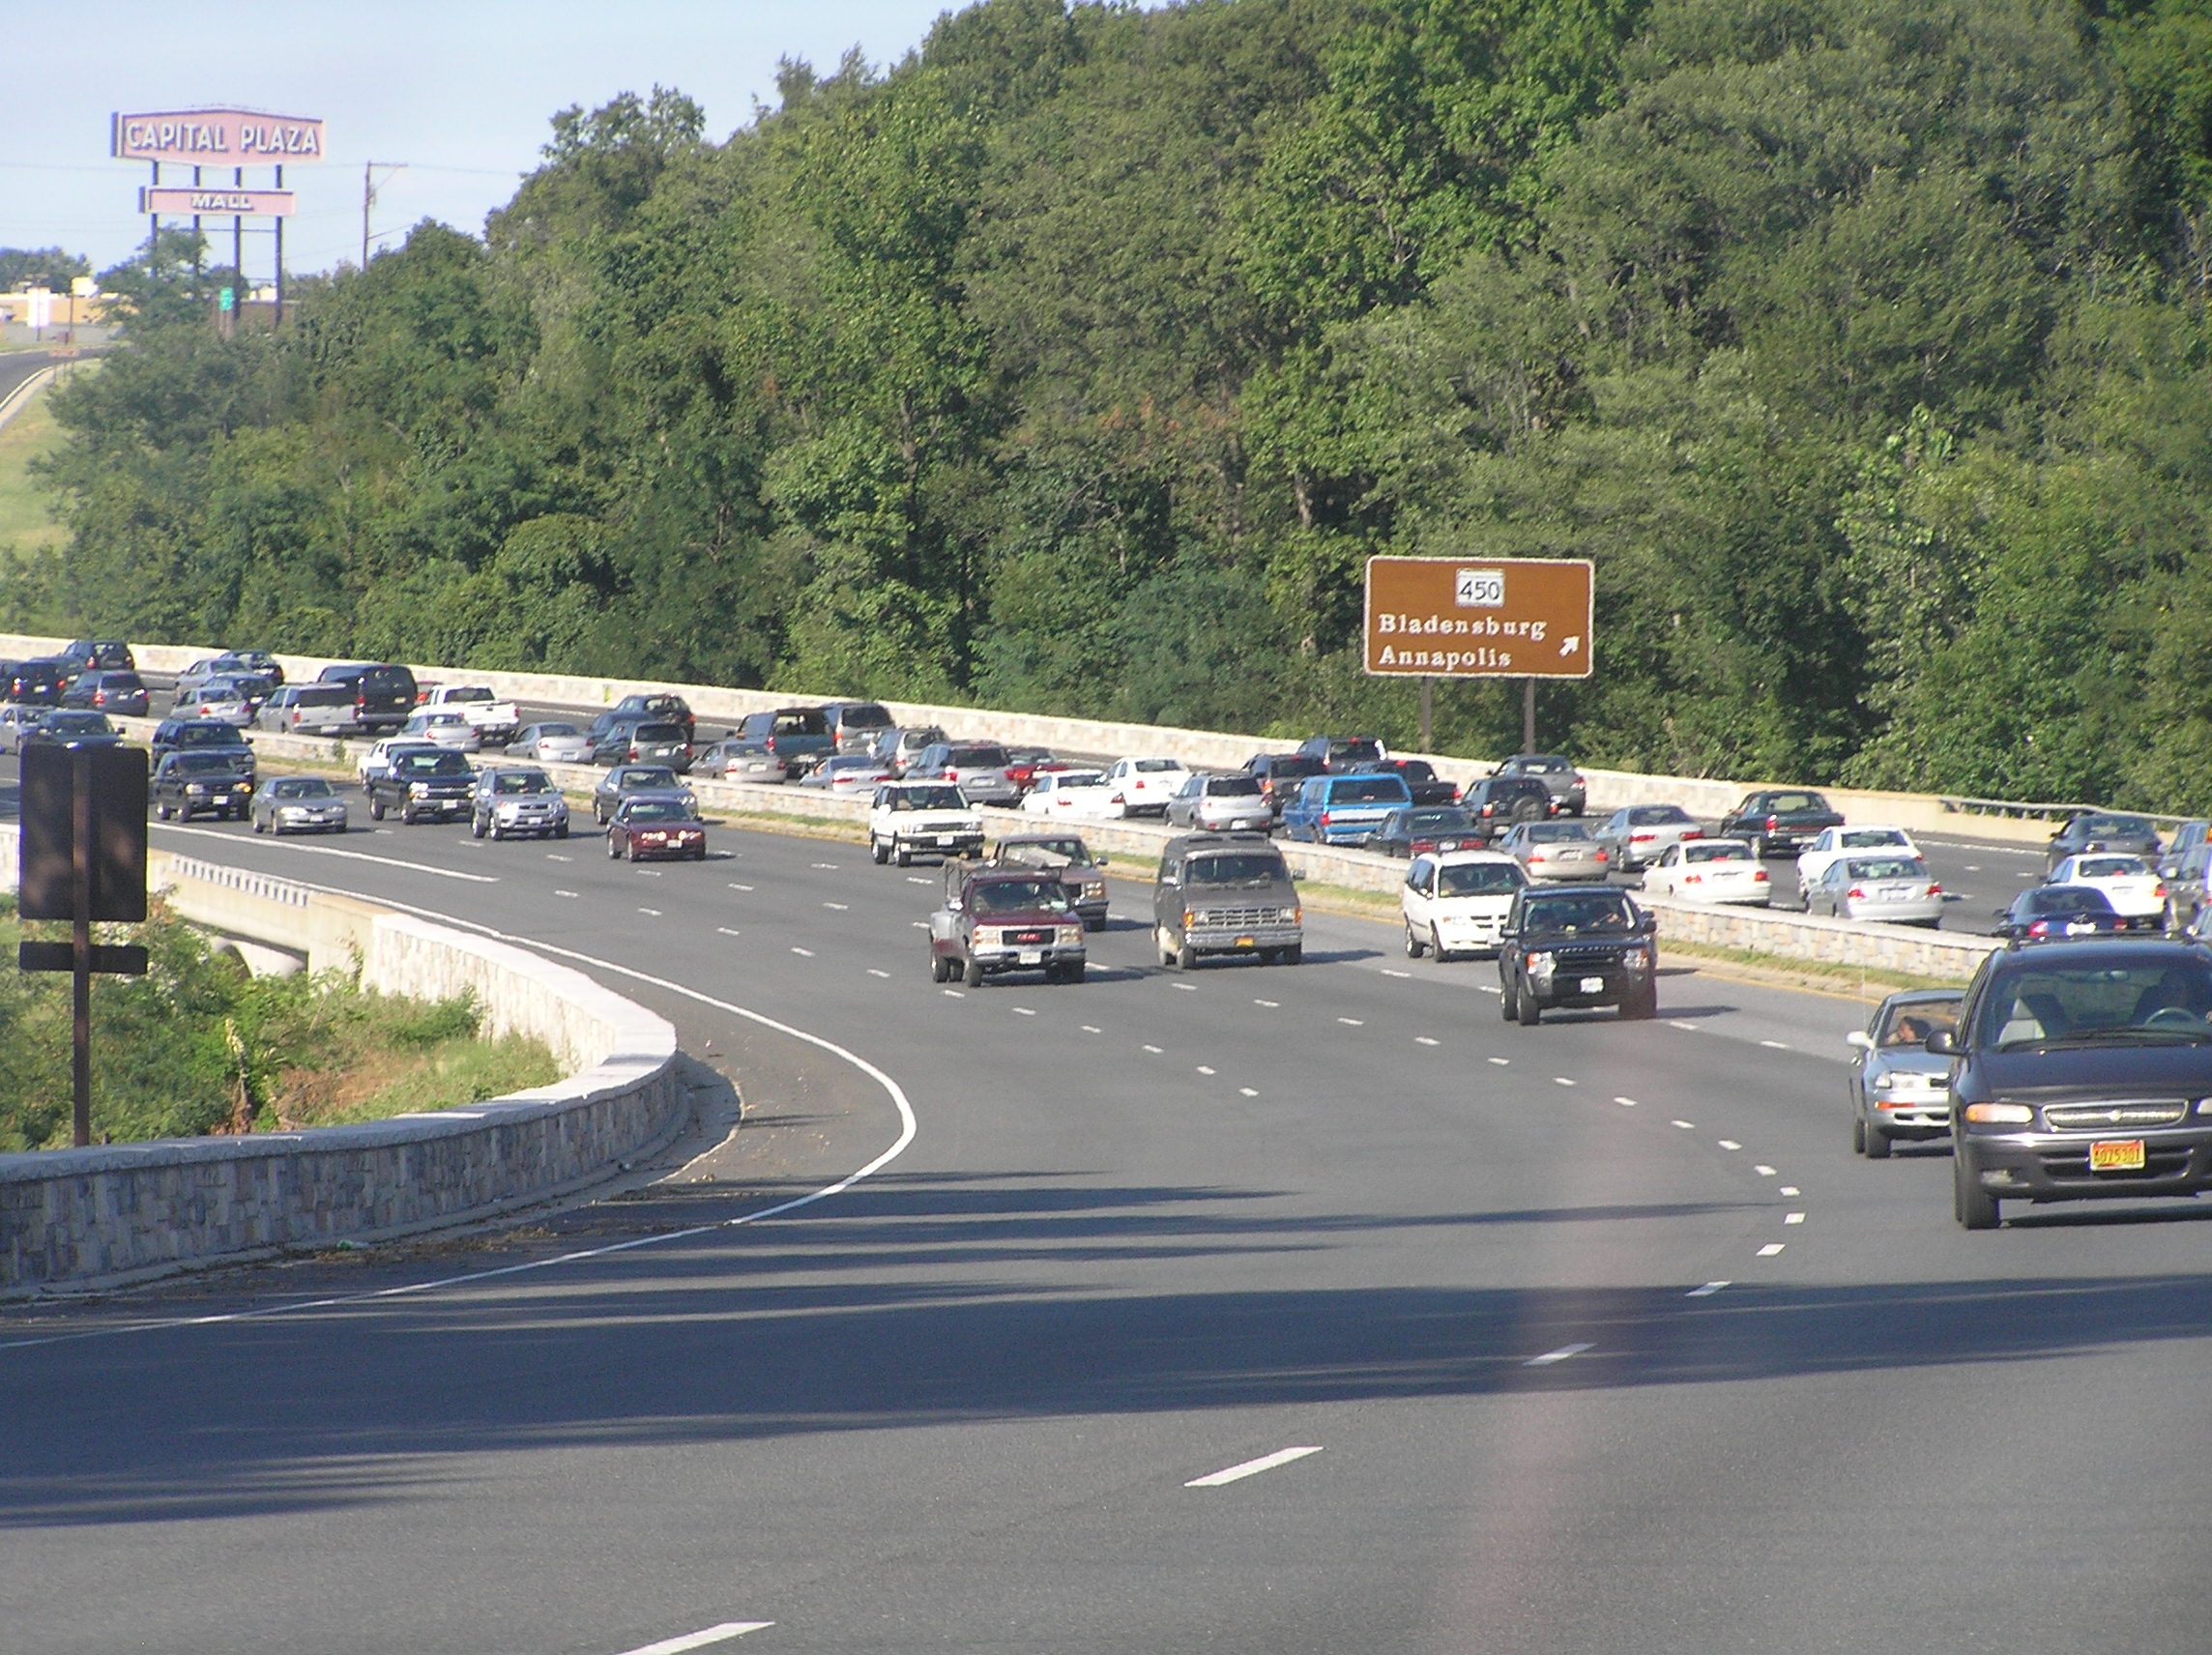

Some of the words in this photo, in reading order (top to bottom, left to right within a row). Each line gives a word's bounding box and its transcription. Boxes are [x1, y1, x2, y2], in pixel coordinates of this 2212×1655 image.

[125, 122, 228, 152] CAPITAL
[239, 125, 320, 156] PLAZA
[190, 193, 254, 211] MALL
[1458, 580, 1500, 600] 450
[1379, 613, 1547, 641] Bladensburg
[1379, 645, 1512, 671] Annapolis
